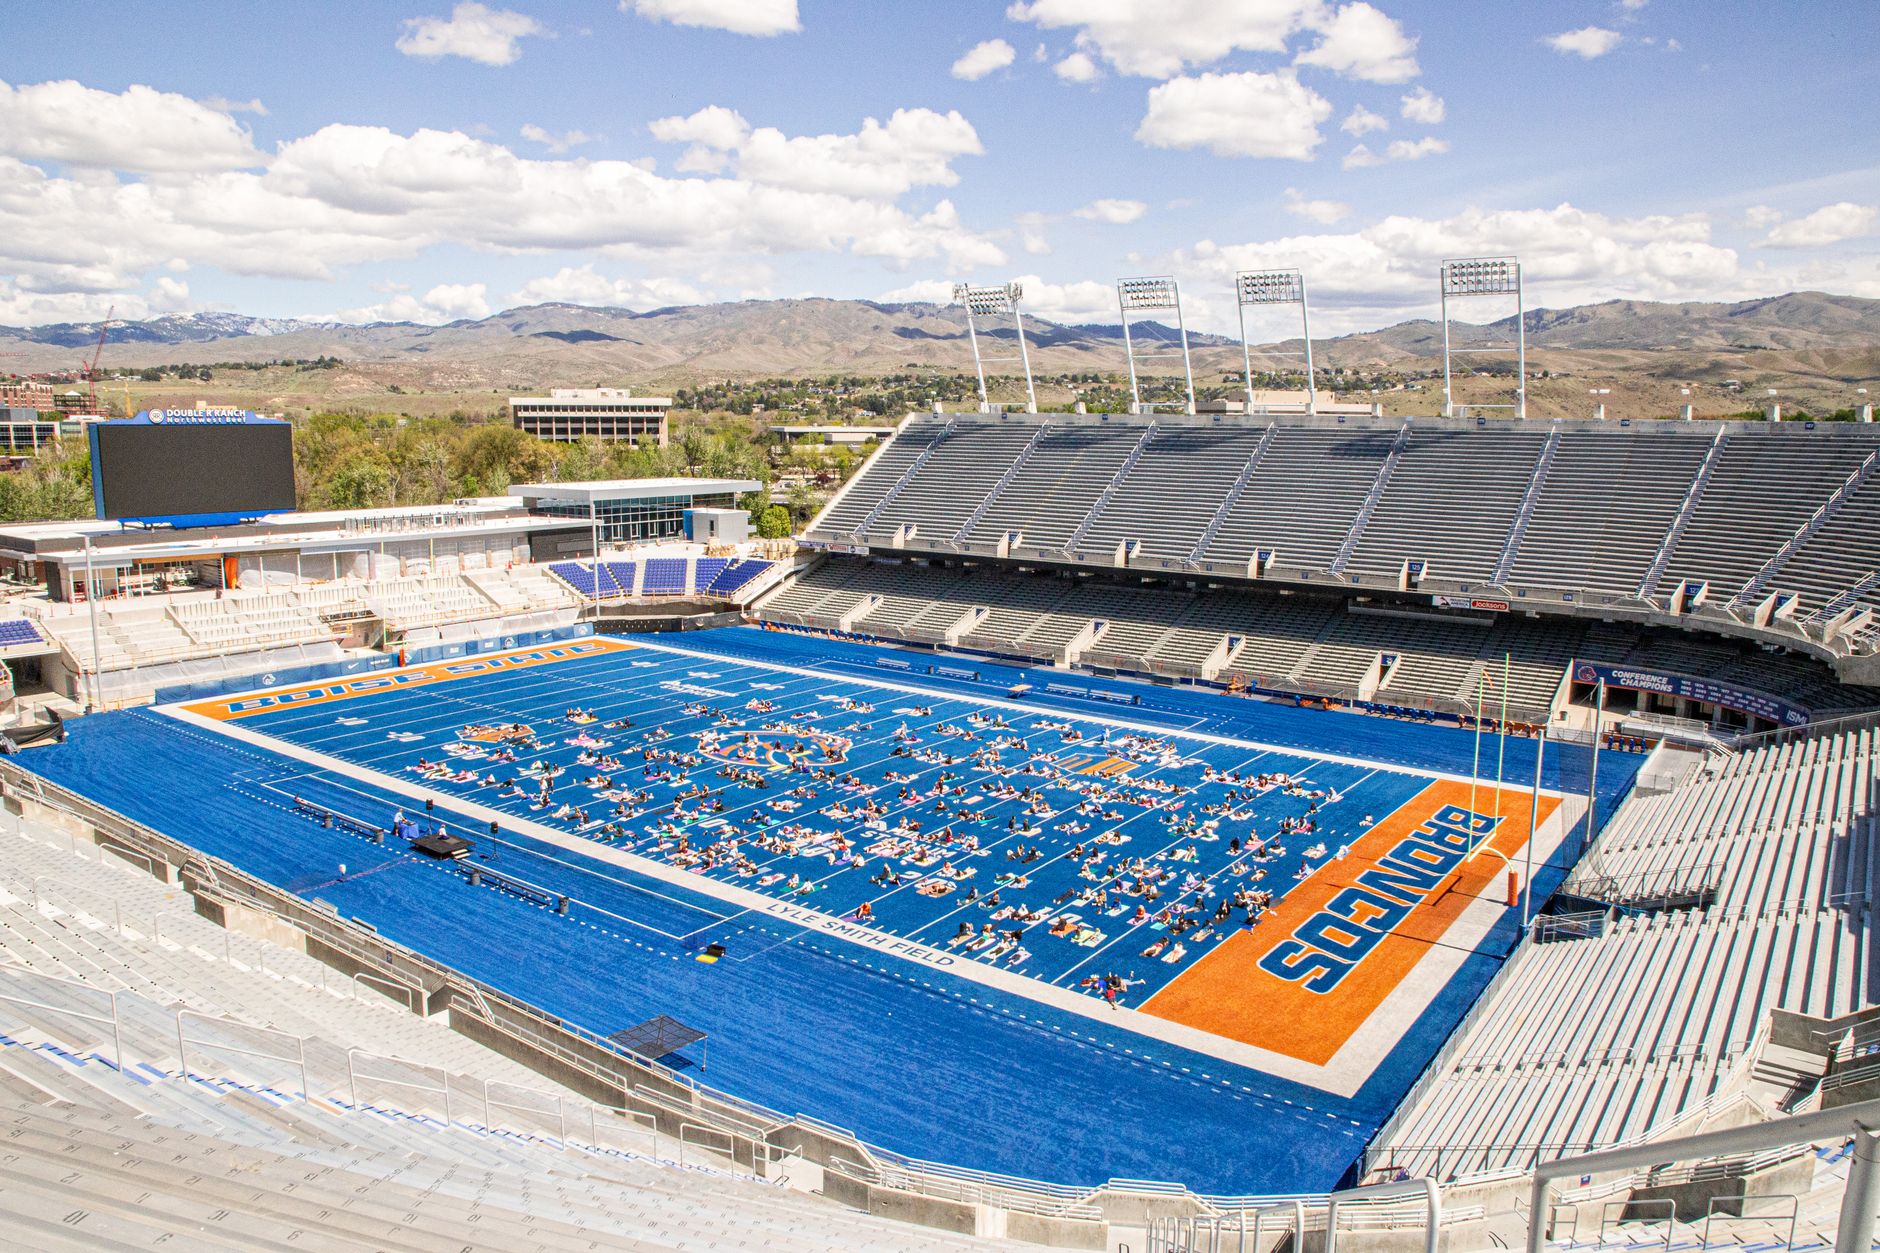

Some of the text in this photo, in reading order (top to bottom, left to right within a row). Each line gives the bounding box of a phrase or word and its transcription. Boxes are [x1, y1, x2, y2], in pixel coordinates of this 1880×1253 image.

[166, 409, 246, 417] DOUBLE R RANCH
[217, 643, 606, 714] BOISE STATE
[1611, 670, 1668, 684] CONFERENCE
[1619, 678, 1673, 692] CHAMPIONS
[1256, 804, 1507, 994] BRONCOS
[766, 903, 955, 967] LYLE SMITH FIELD
